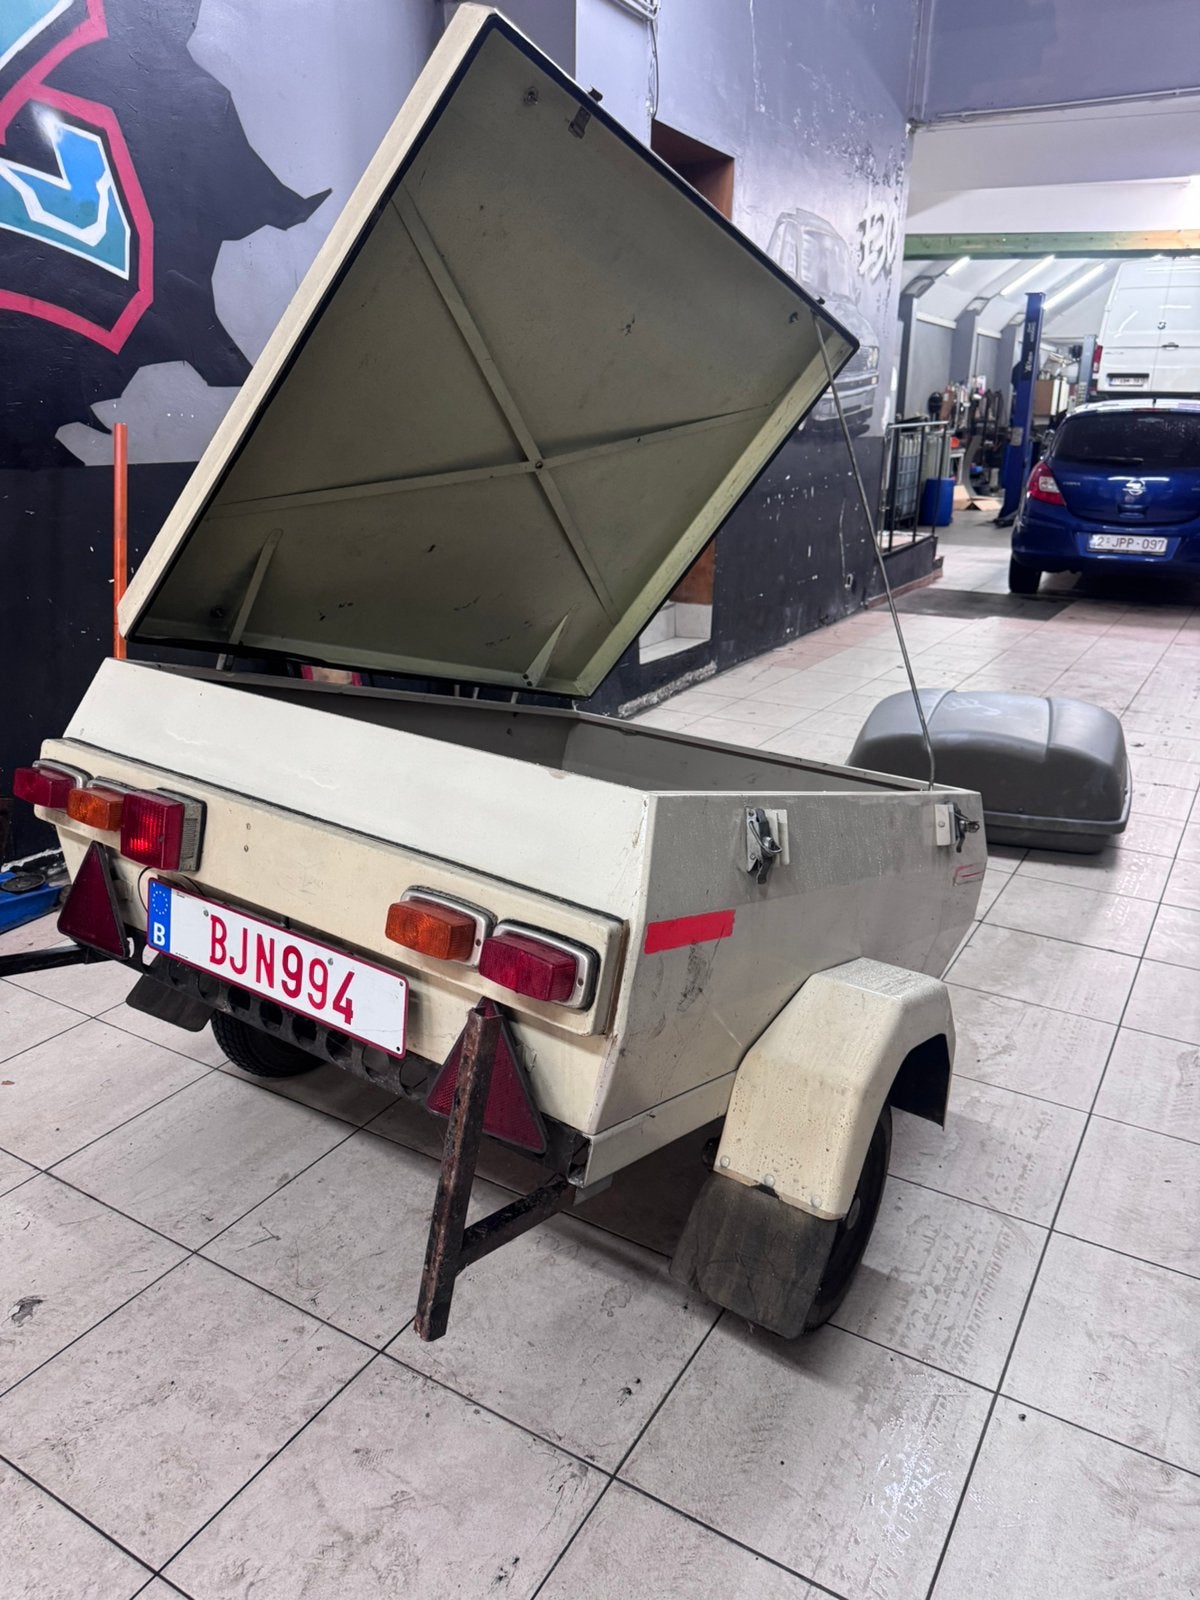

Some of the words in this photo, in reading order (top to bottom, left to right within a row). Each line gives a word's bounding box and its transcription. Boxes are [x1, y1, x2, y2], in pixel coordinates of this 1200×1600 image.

[1097, 536, 1166, 550] 2-JPP-097
[153, 922, 166, 947] B
[209, 914, 355, 1025] BJN994
